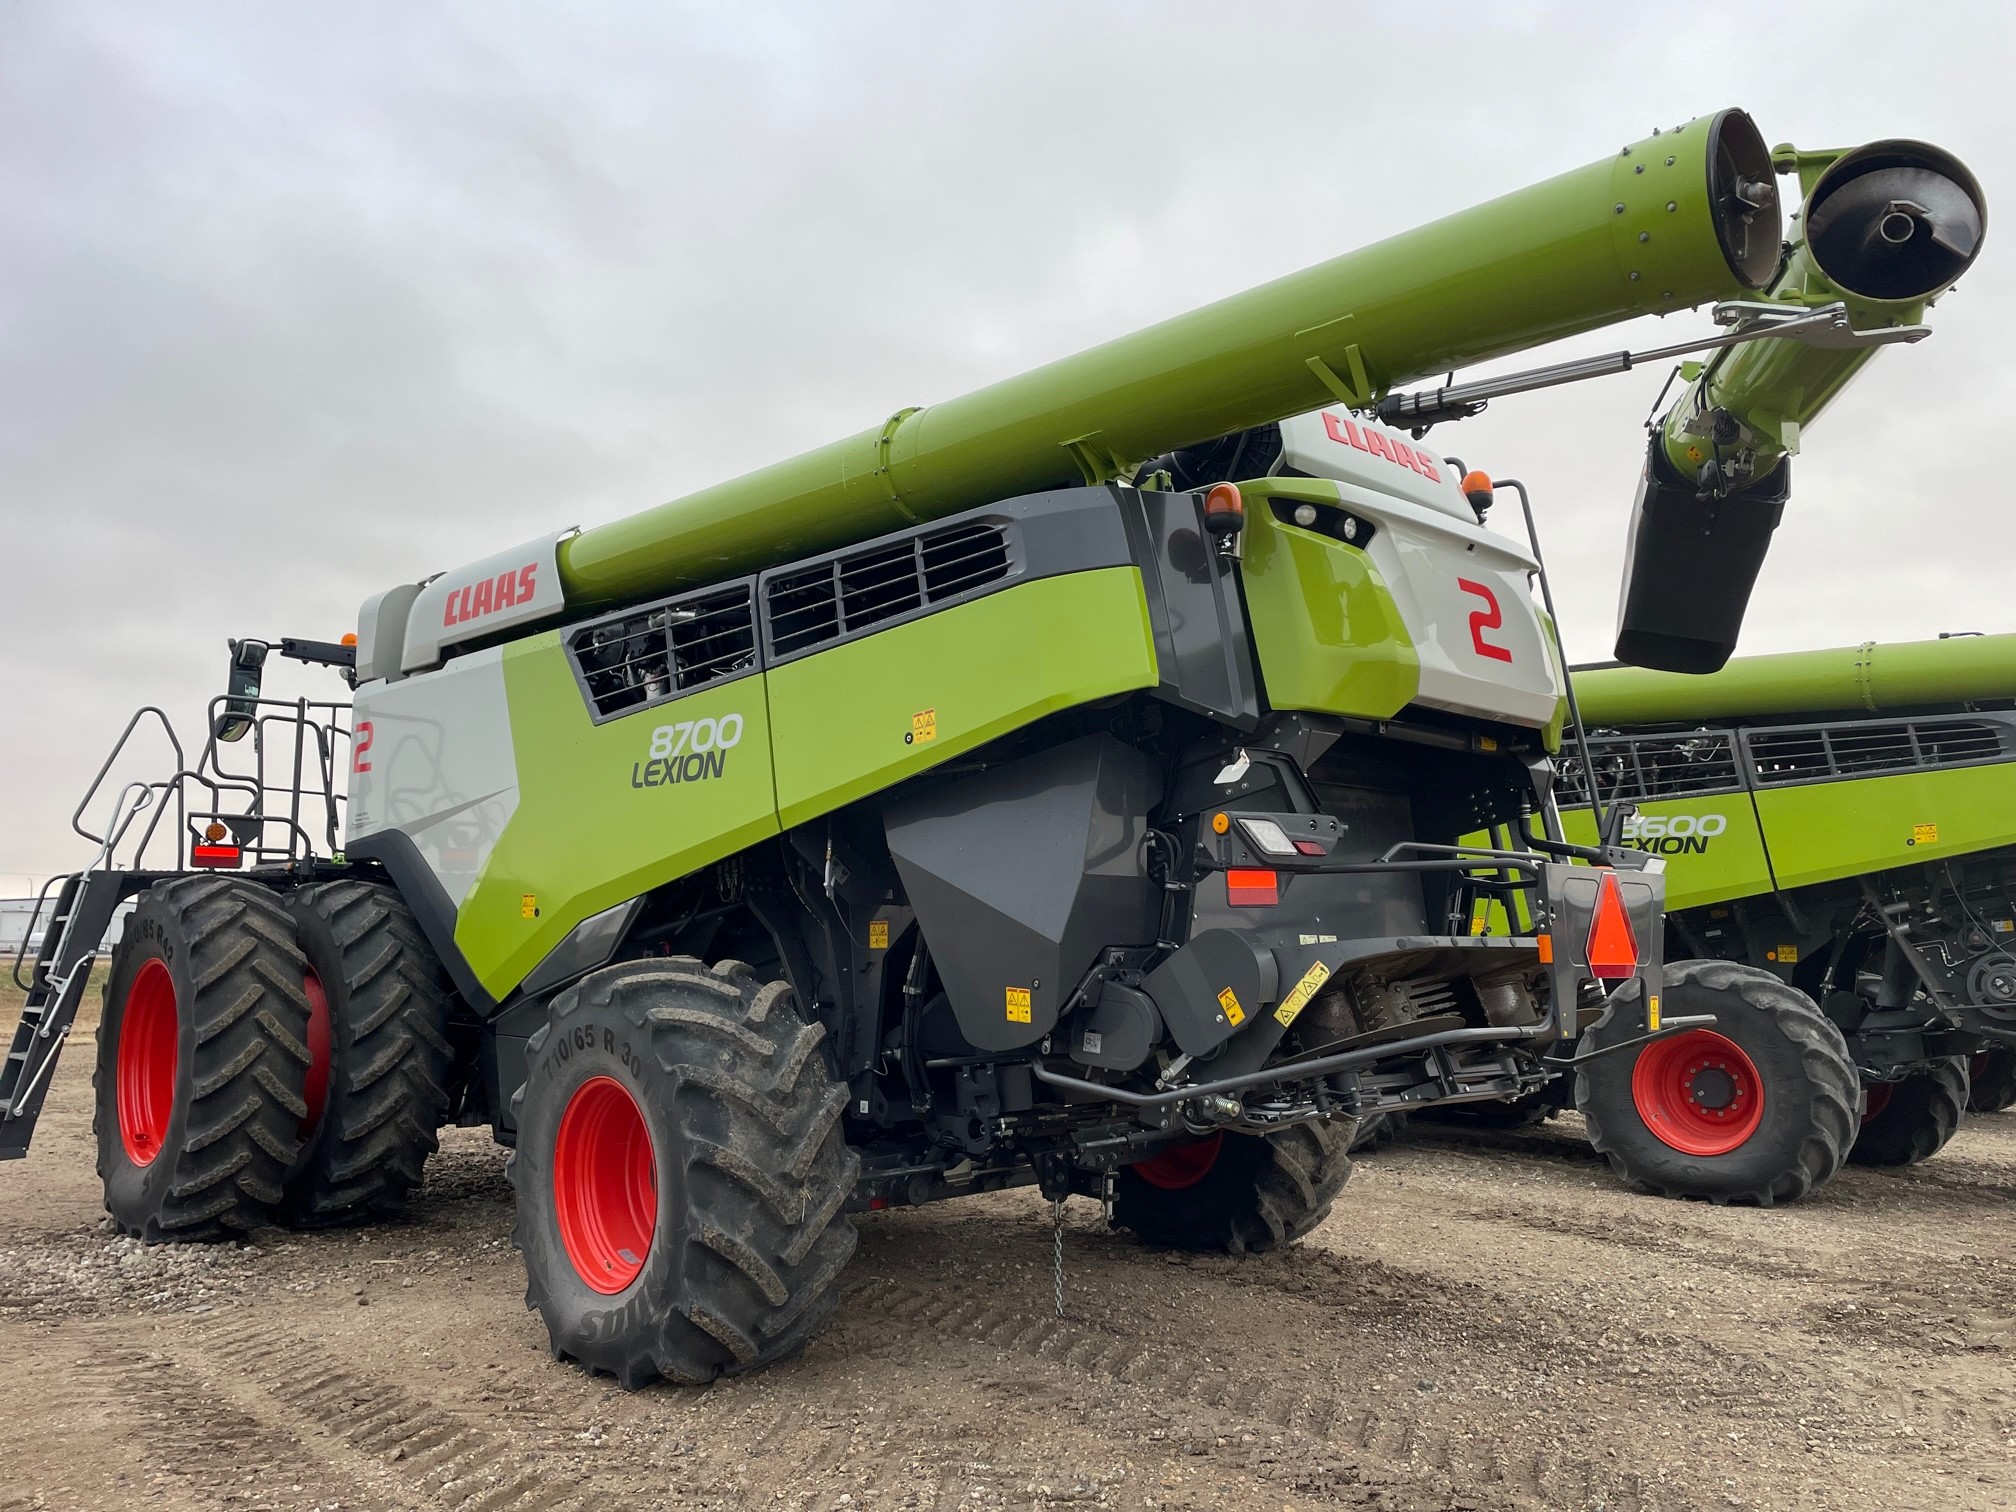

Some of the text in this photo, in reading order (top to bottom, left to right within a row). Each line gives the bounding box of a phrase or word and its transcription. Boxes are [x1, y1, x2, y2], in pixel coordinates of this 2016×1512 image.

[1321, 411, 1441, 484] CLAAS
[443, 562, 538, 628] CLAAS
[1457, 577, 1513, 664] 2
[353, 720, 374, 774] 2
[649, 713, 744, 761] 8700
[631, 749, 727, 789] LEXION
[1619, 836, 1709, 854] EXION
[542, 1023, 641, 1080] 710/65 R 30
